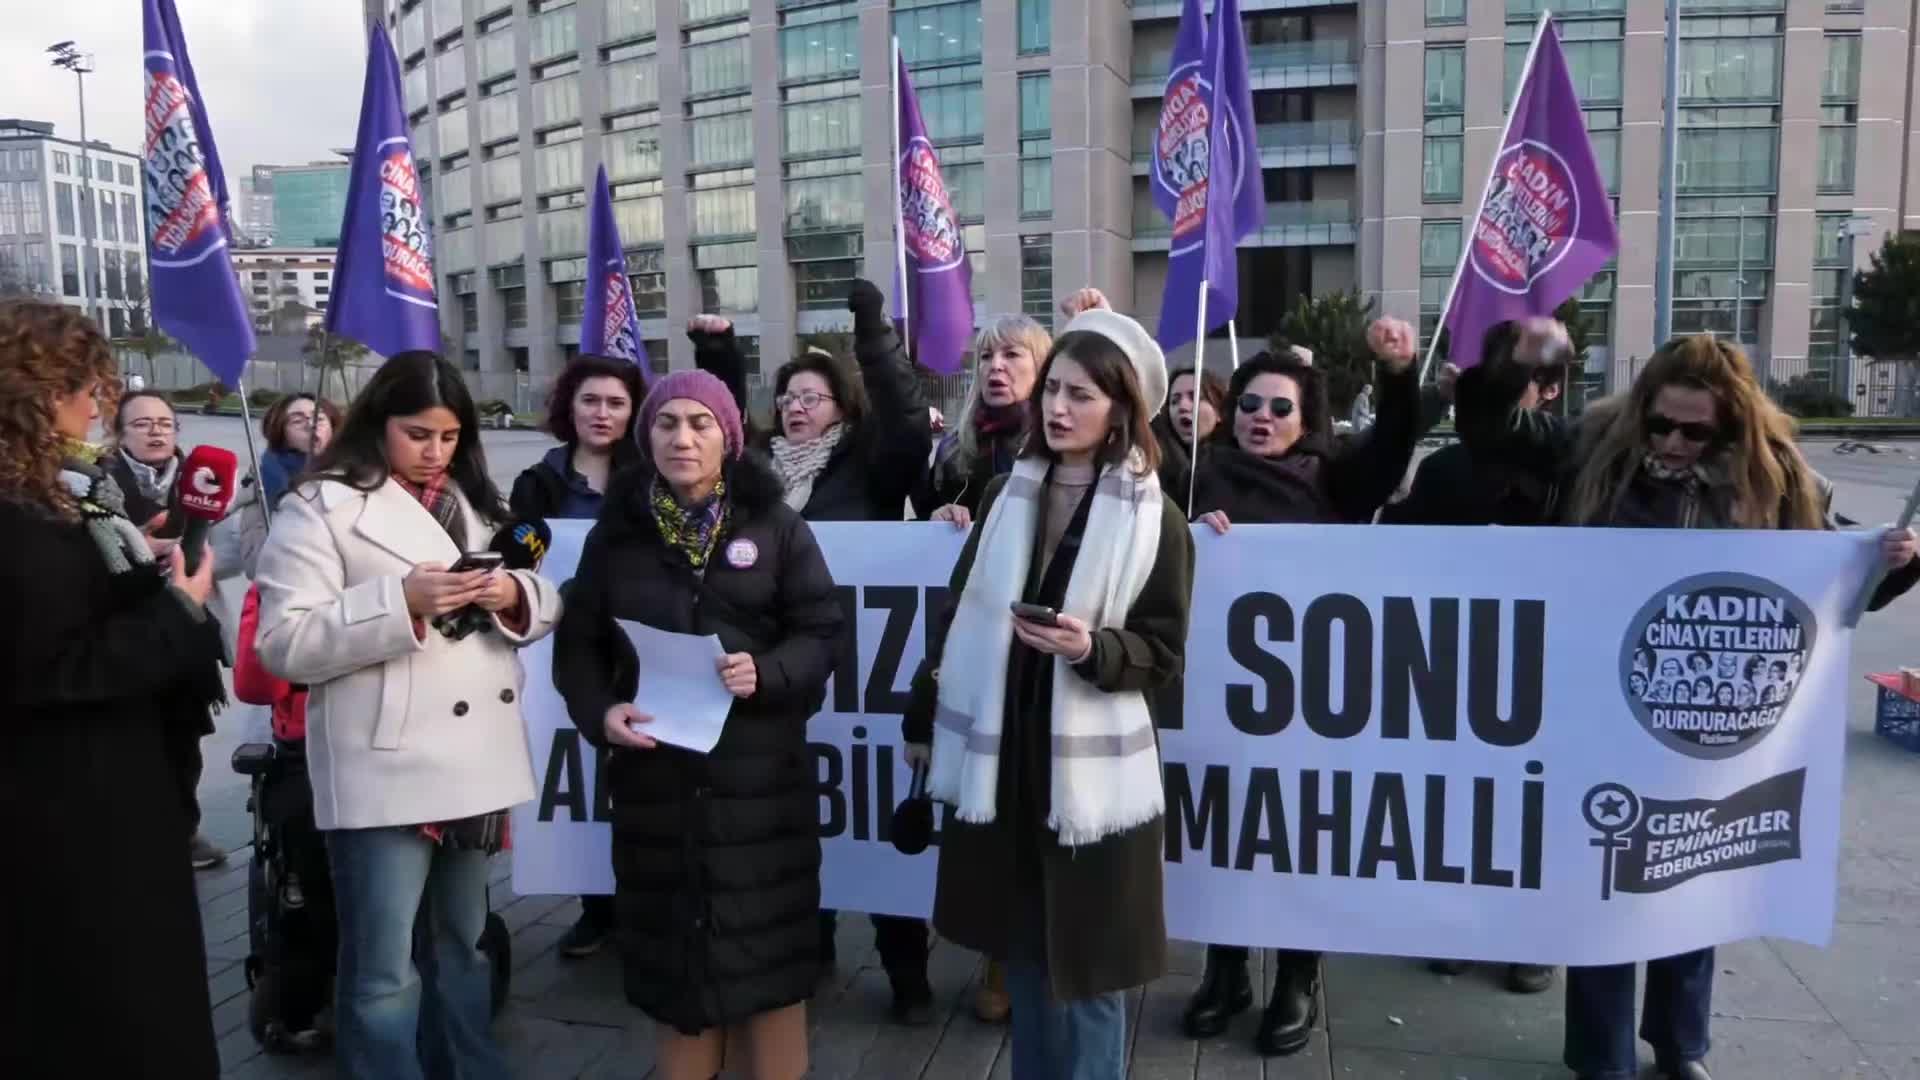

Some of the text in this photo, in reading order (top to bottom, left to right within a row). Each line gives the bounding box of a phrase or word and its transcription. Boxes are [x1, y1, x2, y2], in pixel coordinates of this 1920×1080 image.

[1666, 595, 1785, 623] KADIN
[1646, 619, 1801, 650] CİNAYETLERİNİ
[1225, 591, 1546, 747] SONU
[1652, 703, 1782, 731] DURDURACAĞIZ
[1163, 760, 1544, 889] MAHALLİ
[1647, 808, 1717, 835] GENÇ
[1643, 840, 1757, 881] FEDERASYONU
